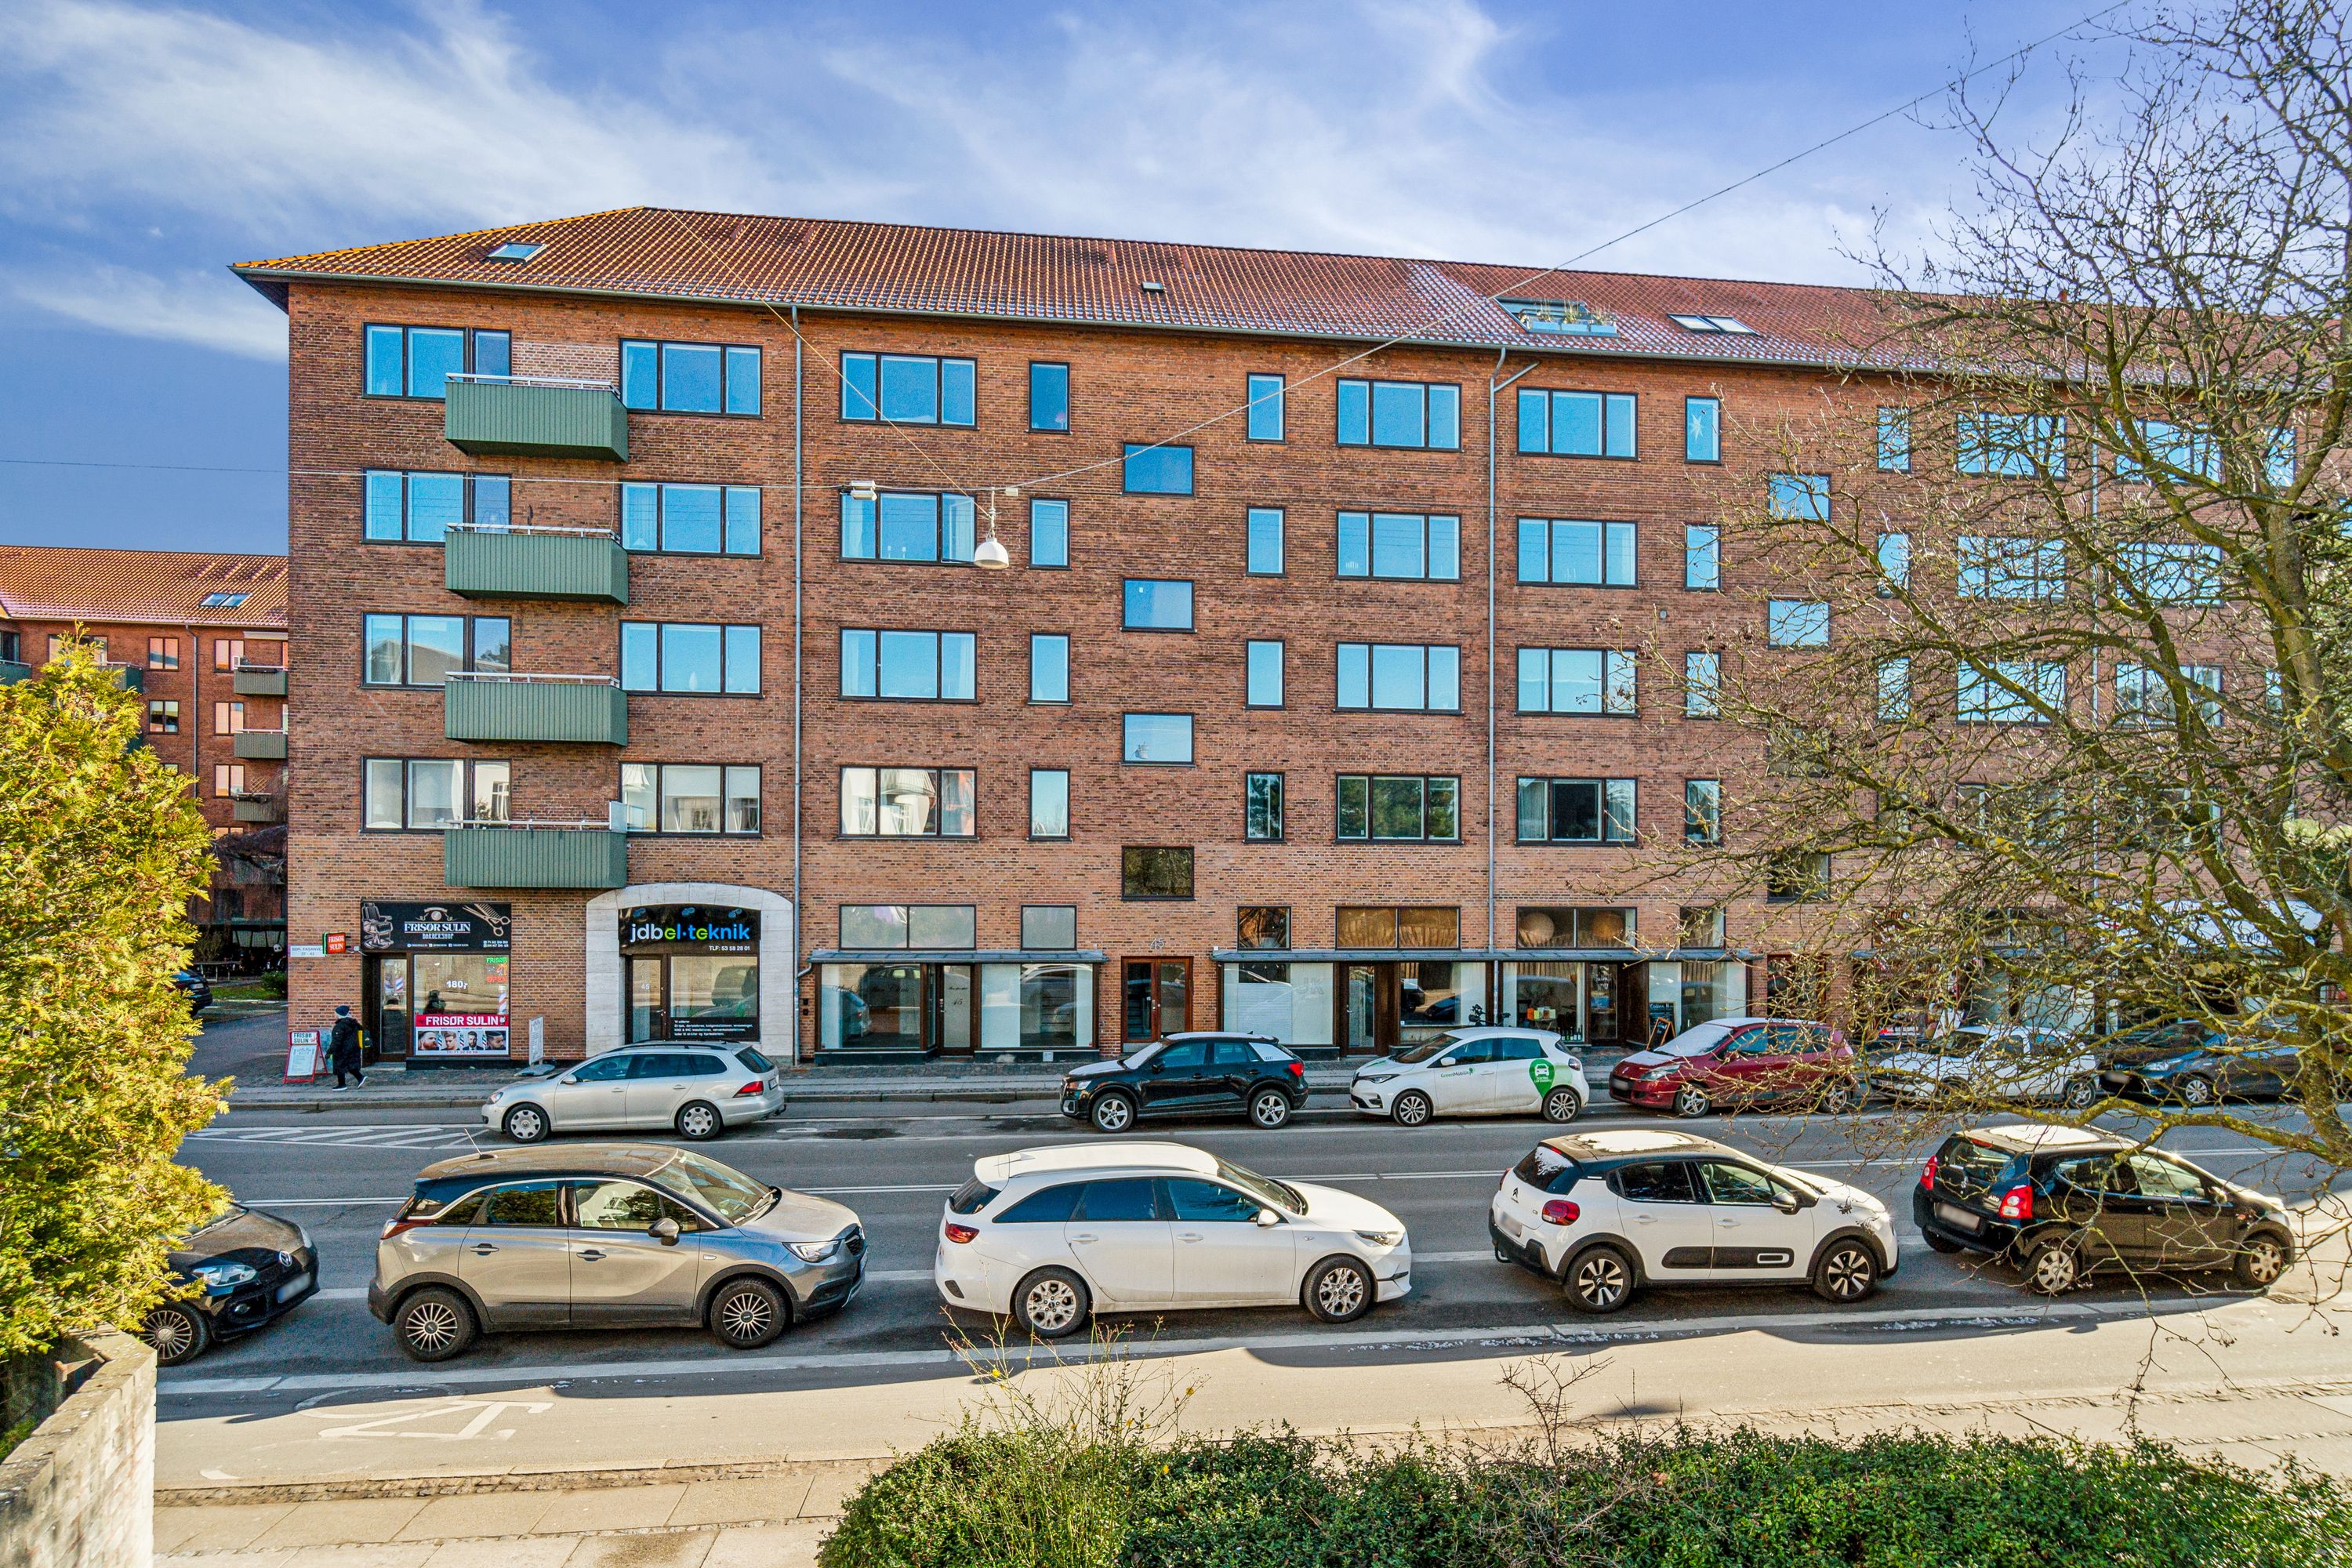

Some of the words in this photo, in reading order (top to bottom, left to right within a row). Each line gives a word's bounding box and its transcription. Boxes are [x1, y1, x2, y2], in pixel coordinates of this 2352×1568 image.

[405, 922, 441, 932] FRISØR
[441, 922, 470, 931] SULIN
[1150, 938, 1165, 949] 45
[426, 1016, 464, 1025] FRISØR
[466, 1016, 499, 1025] SULIN
